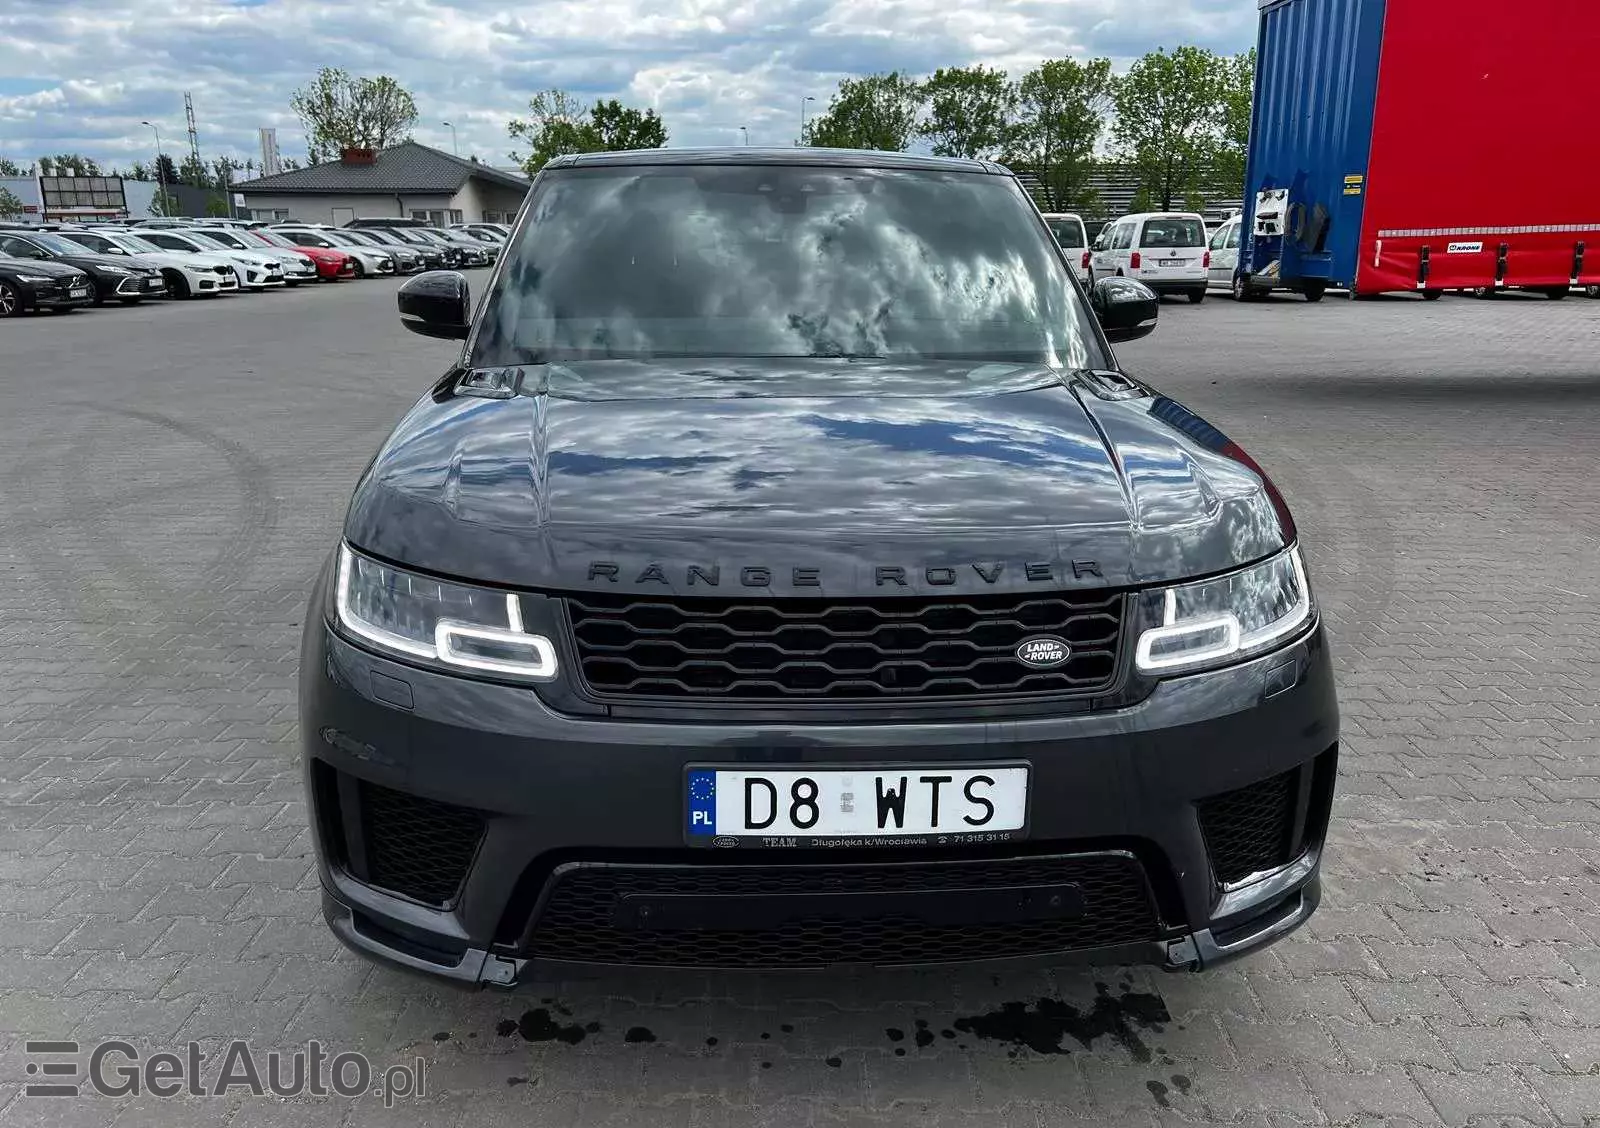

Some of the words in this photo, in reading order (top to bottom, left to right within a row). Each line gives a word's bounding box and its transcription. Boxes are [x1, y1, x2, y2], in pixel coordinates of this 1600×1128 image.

[588, 559, 821, 587] RANGE
[875, 558, 1104, 587] ROVER
[1027, 643, 1054, 652] LAND
[1030, 650, 1063, 660] ROVER
[744, 777, 819, 830] D8
[875, 775, 996, 829] WTS
[693, 810, 712, 825] PL
[762, 837, 797, 847] TEAM
[954, 835, 964, 843] 71
[986, 833, 996, 841] 31
